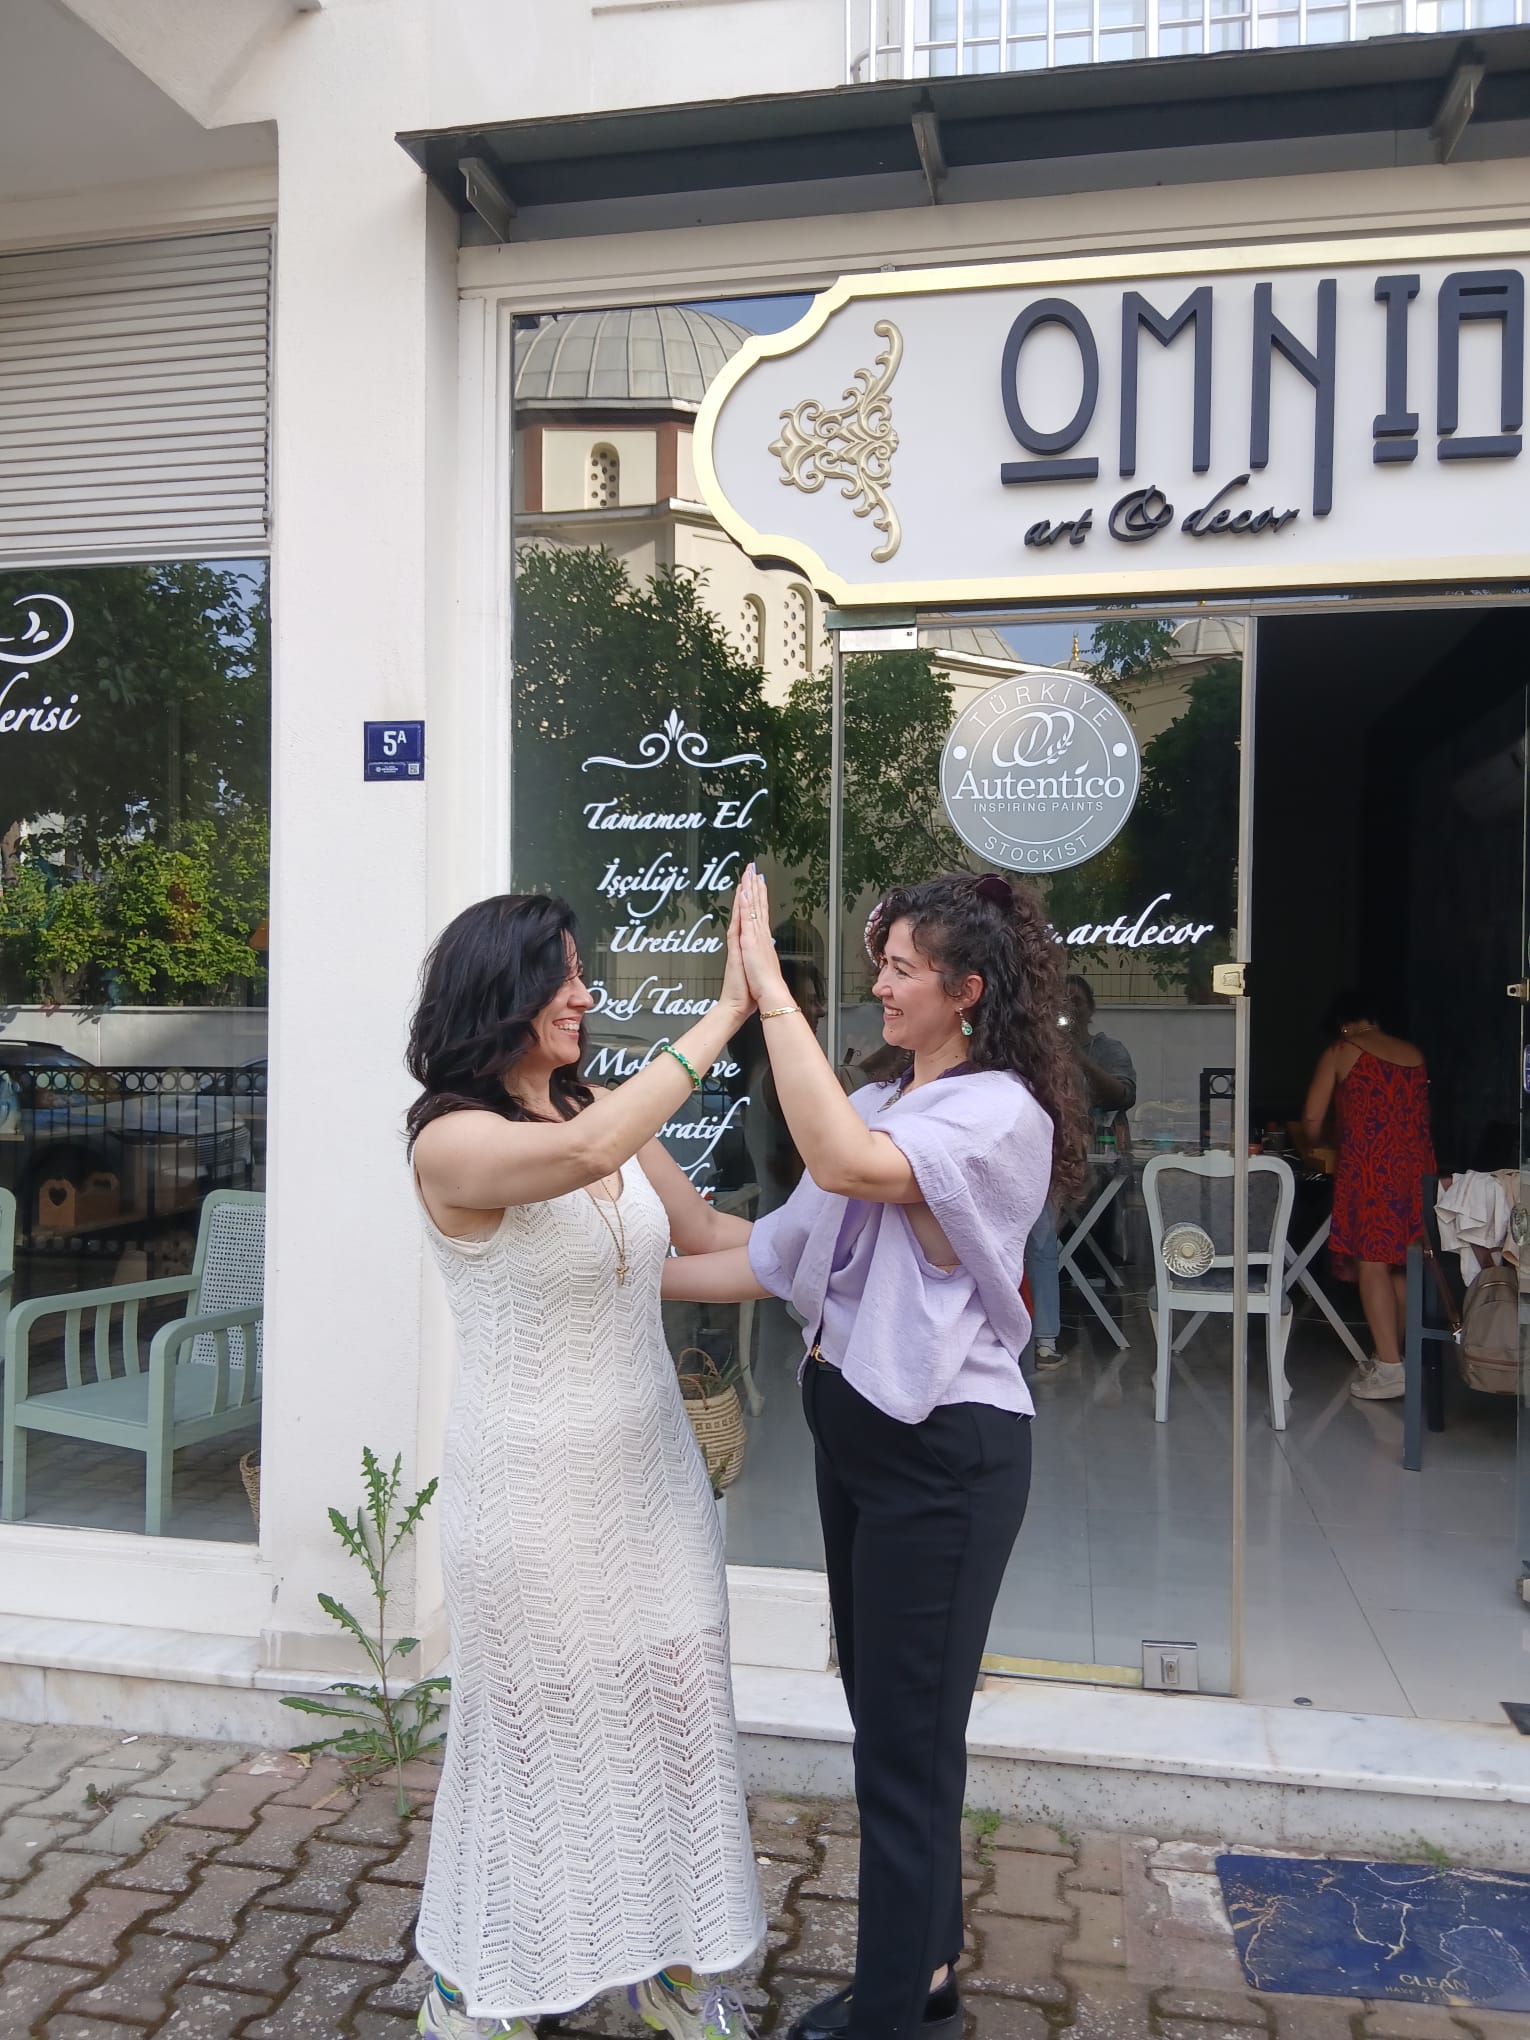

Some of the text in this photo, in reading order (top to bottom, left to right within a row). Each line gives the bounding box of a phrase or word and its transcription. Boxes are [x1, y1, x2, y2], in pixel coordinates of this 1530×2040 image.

[1001, 269, 1525, 516] OMNIA
[1024, 508, 1093, 546] art
[1181, 473, 1301, 537] decor
[969, 683, 1113, 728] TÜRKİYE
[583, 788, 769, 830] Tamamen El
[974, 801, 1104, 813] INSPIRING PAINTS
[984, 834, 1088, 863] STOCKIST
[597, 850, 740, 918] İşçiliği İle
[610, 913, 723, 953] Üretilen
[585, 976, 658, 1021] Özel
[711, 1060, 741, 1079] ve
